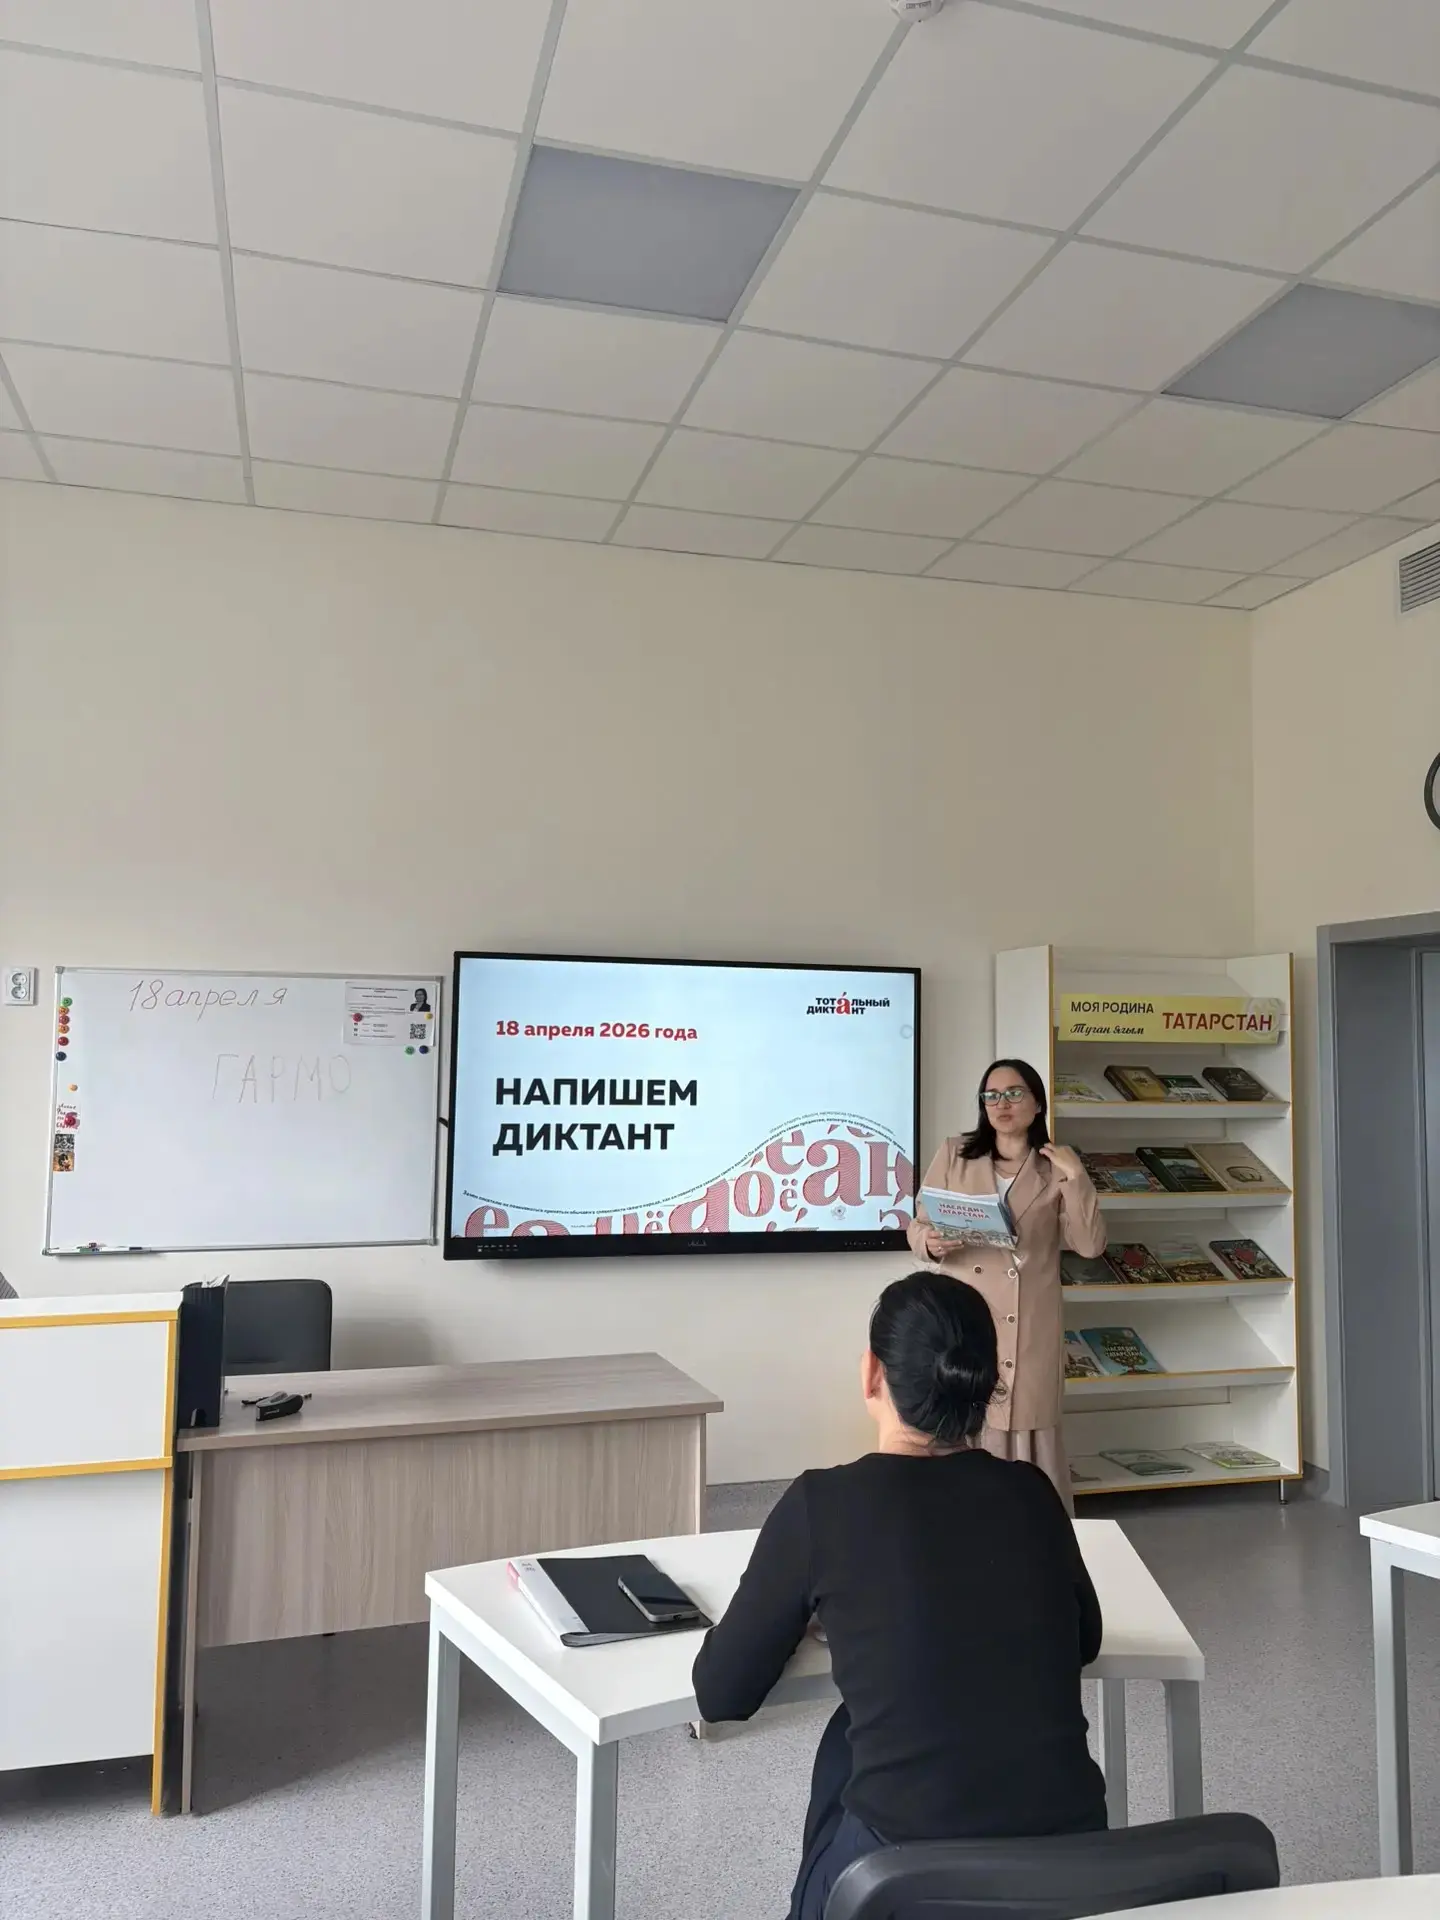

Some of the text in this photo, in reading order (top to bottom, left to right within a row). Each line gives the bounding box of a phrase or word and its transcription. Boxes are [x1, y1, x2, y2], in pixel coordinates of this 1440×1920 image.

[165, 987, 288, 1022] апреля
[1071, 1001, 1154, 1015] МОЯ РОДИНА
[496, 1020, 698, 1041] 18 апреля 2026 года
[1070, 1023, 1111, 1036] Туган
[1162, 1012, 1273, 1031] ТАТАРСТАН
[212, 1053, 352, 1103] ГАРМО
[496, 1078, 698, 1106] НАПИШЕМ
[492, 1123, 675, 1156] ДИКТАНТ
